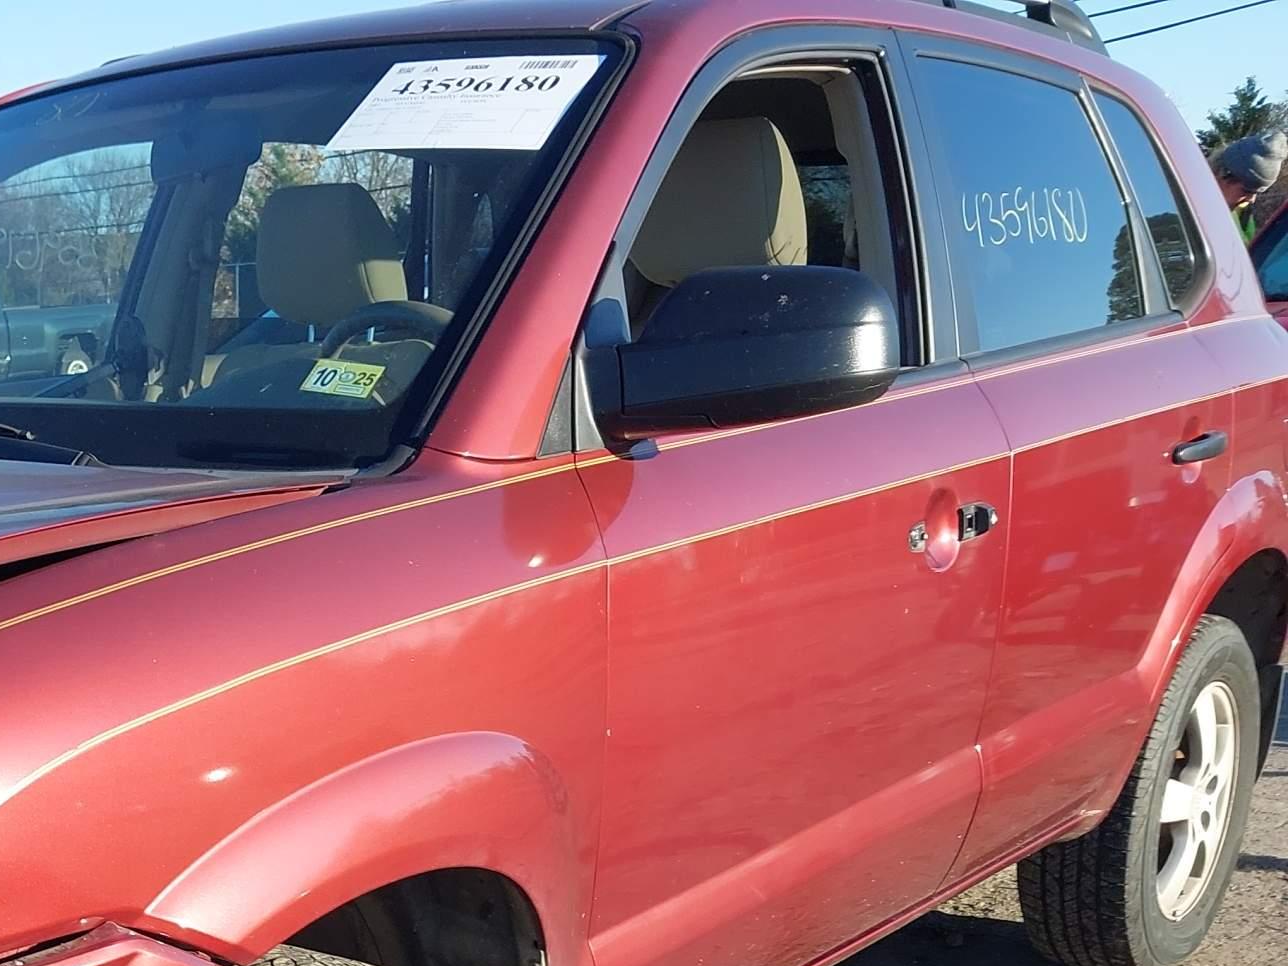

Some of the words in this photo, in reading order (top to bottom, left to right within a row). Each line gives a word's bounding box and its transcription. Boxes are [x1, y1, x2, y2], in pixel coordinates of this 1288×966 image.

[392, 75, 561, 95] 43596180
[961, 186, 1088, 248] 43596180
[312, 367, 338, 387] 10
[353, 371, 377, 387] 25
